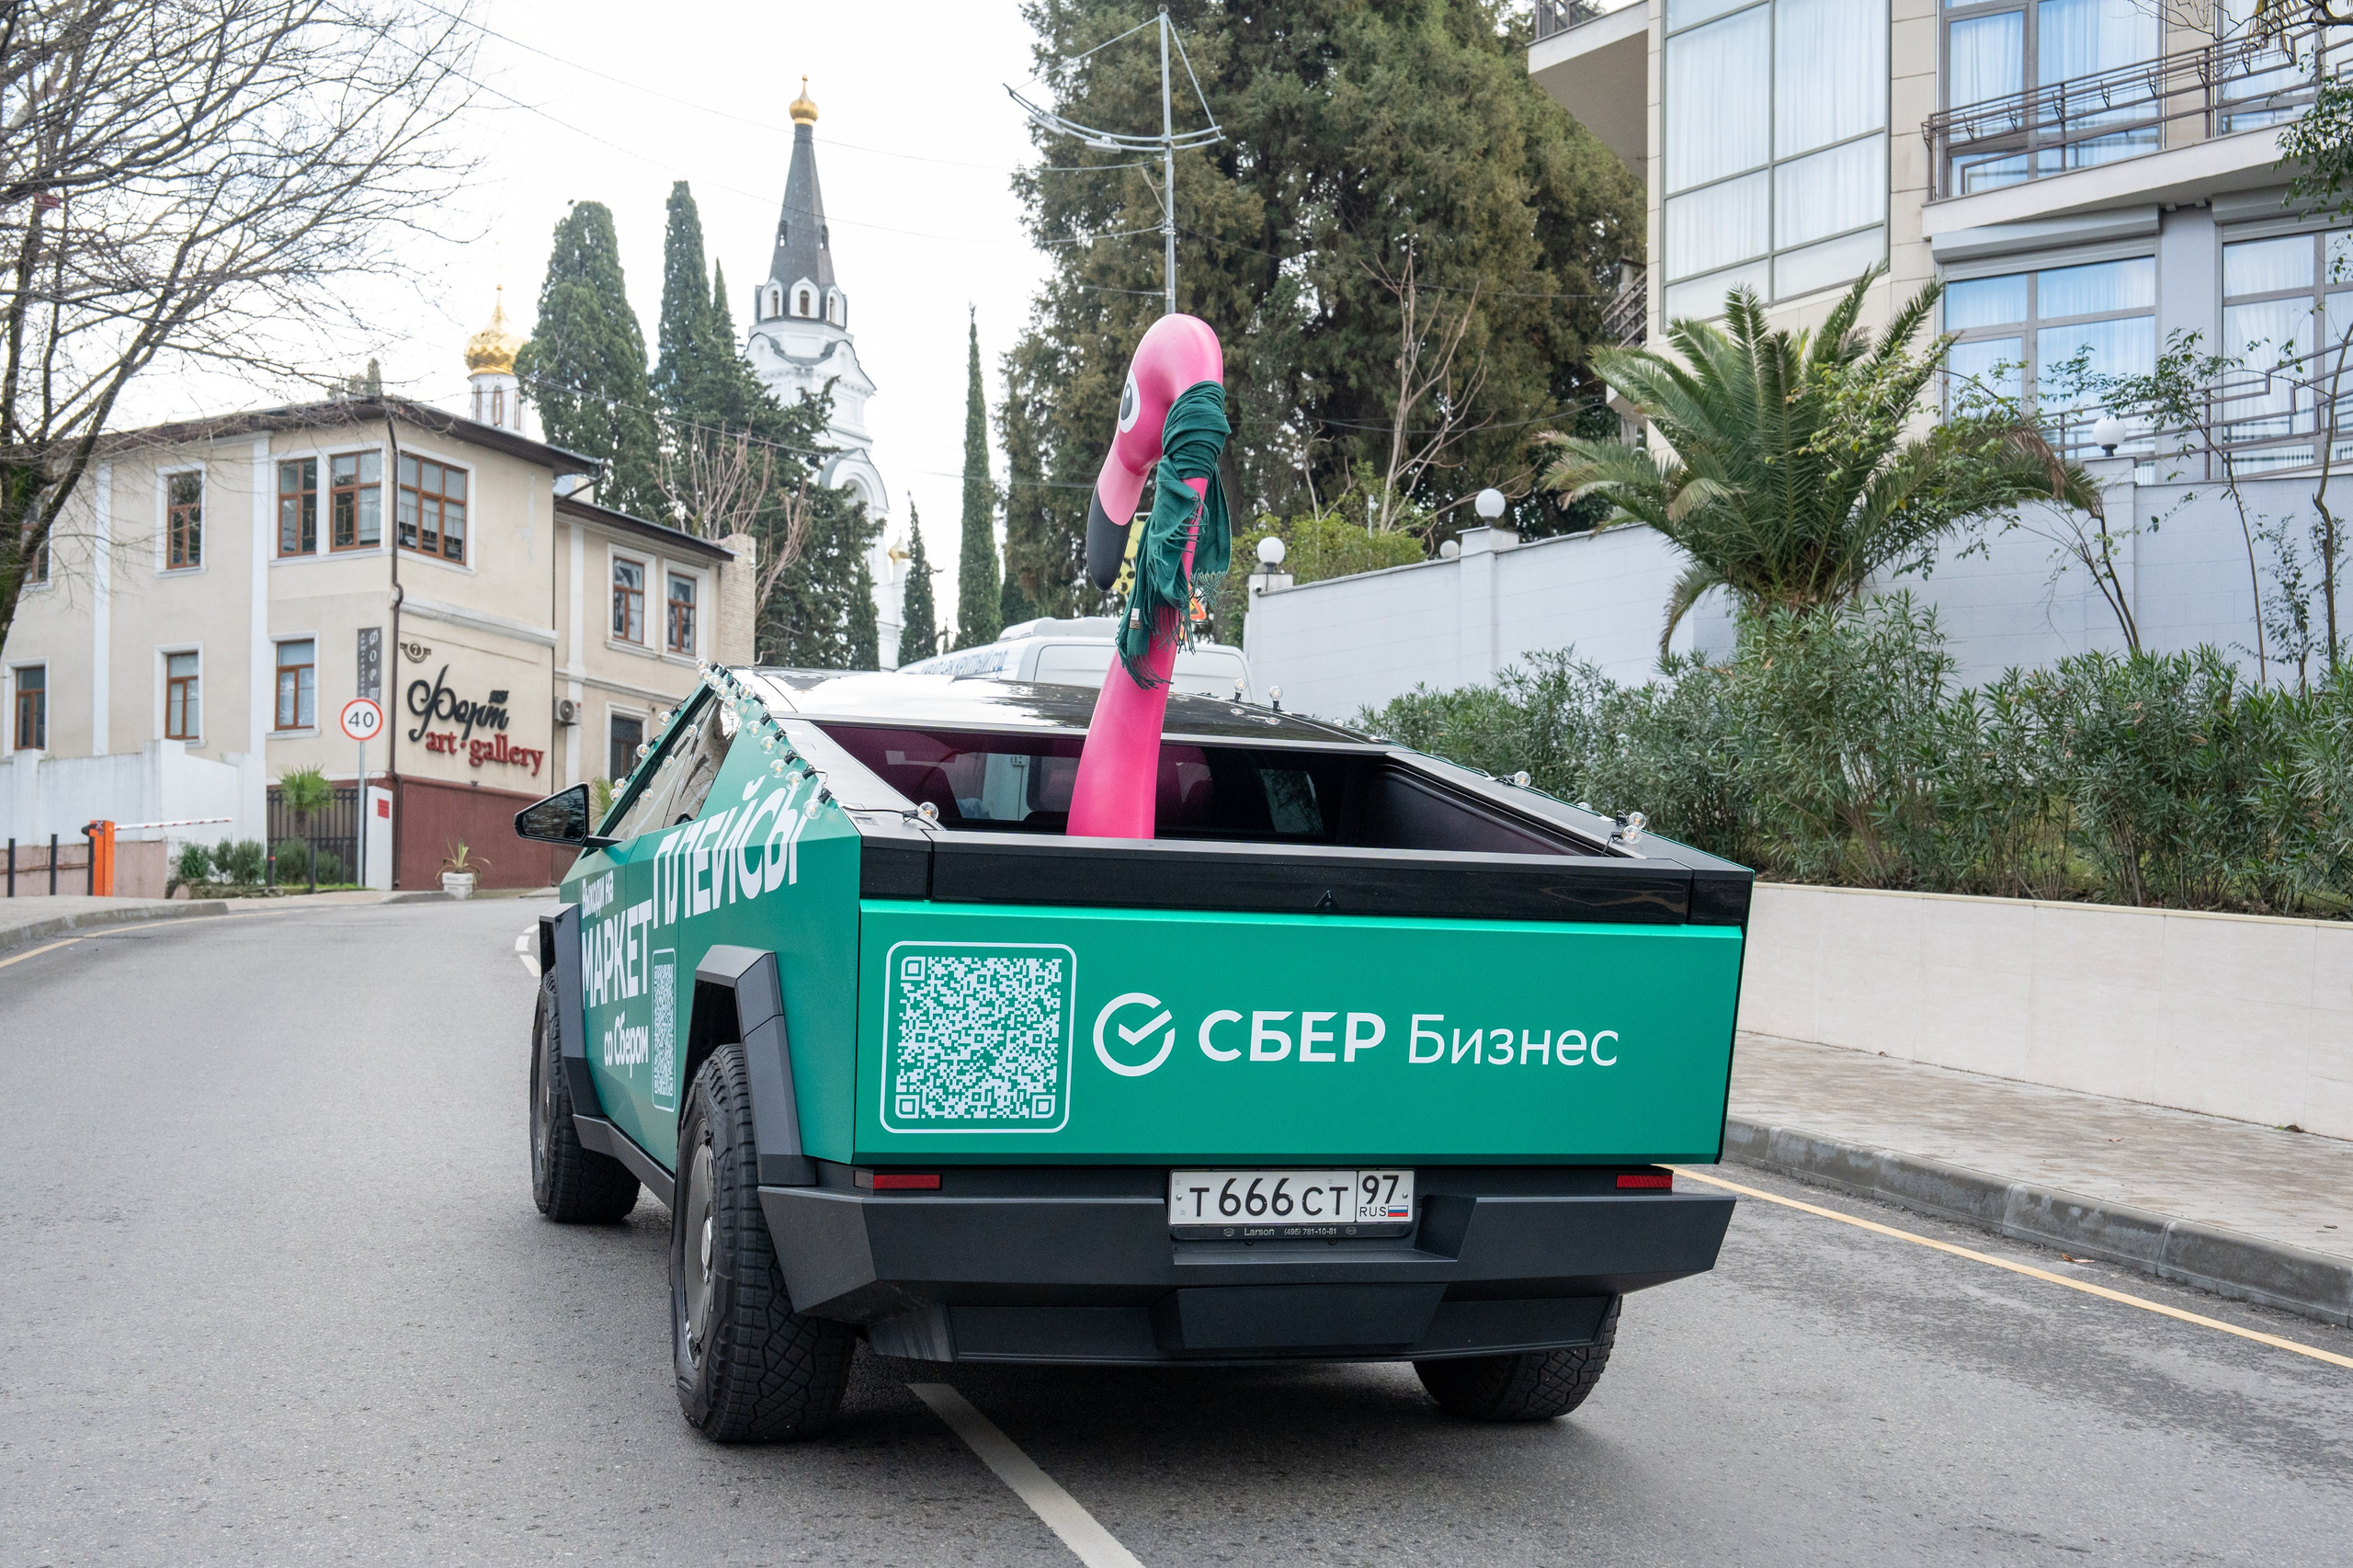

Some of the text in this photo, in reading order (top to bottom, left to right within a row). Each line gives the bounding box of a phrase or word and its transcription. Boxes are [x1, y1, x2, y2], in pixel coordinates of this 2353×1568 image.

[413, 645, 419, 656] 7
[348, 711, 374, 728] 40
[426, 732, 545, 777] art gallery
[582, 775, 821, 1010] МАРКЕТ ПЛЕЙСЫ
[582, 870, 614, 919] Выходи на
[604, 1010, 649, 1078] со Сбером
[1198, 1009, 1619, 1066] СБЕР Бизнес
[1361, 1175, 1400, 1205] 97
[1359, 1206, 1387, 1217] RUS
[1244, 1227, 1275, 1236] Larson
